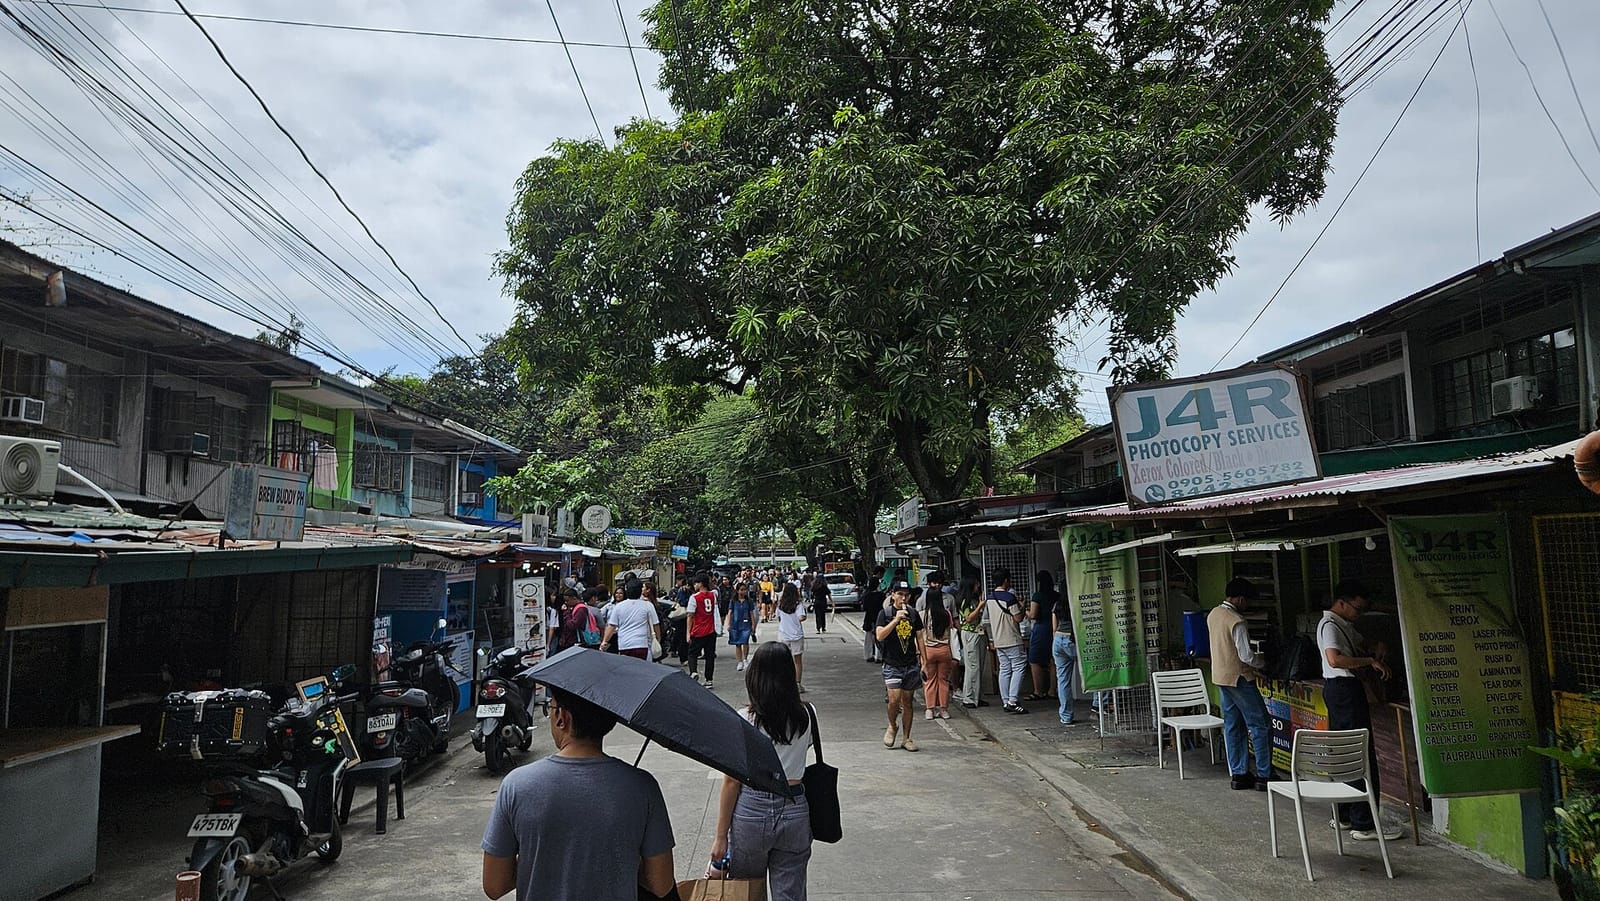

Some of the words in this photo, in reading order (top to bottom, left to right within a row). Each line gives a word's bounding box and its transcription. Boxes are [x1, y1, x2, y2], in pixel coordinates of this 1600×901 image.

[1126, 378, 1298, 442] J4R
[1128, 432, 1222, 461] PHOTOCOPY
[1229, 420, 1301, 446] SERVICES
[1131, 462, 1165, 485] Xerox
[258, 485, 276, 503] BREW
[276, 487, 297, 505] BUDDY
[296, 489, 305, 507] PH
[1076, 529, 1125, 547] J4R
[1415, 529, 1496, 552] J4R
[704, 598, 712, 613] 9
[1449, 604, 1476, 614] PRINT
[1449, 615, 1480, 626] XEROX
[1086, 623, 1104, 631] POSTER
[1086, 630, 1105, 639] STICKER
[1418, 631, 1456, 641] BOOKBIND
[1472, 629, 1496, 638] LASER
[1422, 644, 1456, 654] COILBIND
[1474, 642, 1499, 651] PHOTO
[1499, 641, 1520, 650] PRINT
[1424, 656, 1458, 667] RINGBIND
[1484, 655, 1505, 664] RUSH
[1505, 654, 1513, 662] ID
[1425, 669, 1460, 680] WIREBIND
[1479, 666, 1521, 677] LAMINATION
[1430, 682, 1459, 692] POSTER
[1481, 680, 1503, 689] YEAR
[1503, 679, 1523, 688] BOOK
[1431, 695, 1462, 705] STICKER
[1486, 692, 1523, 703] ENVELOPE
[1430, 708, 1467, 719] MAGAZINE
[1492, 705, 1520, 715] FLYERS
[1425, 722, 1448, 732] NEWS
[1448, 720, 1475, 730] LETTER
[1488, 718, 1528, 728] INVITATION
[1424, 735, 1457, 745] CALLING
[1458, 733, 1478, 743] CARD
[1487, 731, 1531, 742] BROCHURES
[1497, 747, 1523, 759] PRINT
[193, 818, 238, 832] 475TBK
